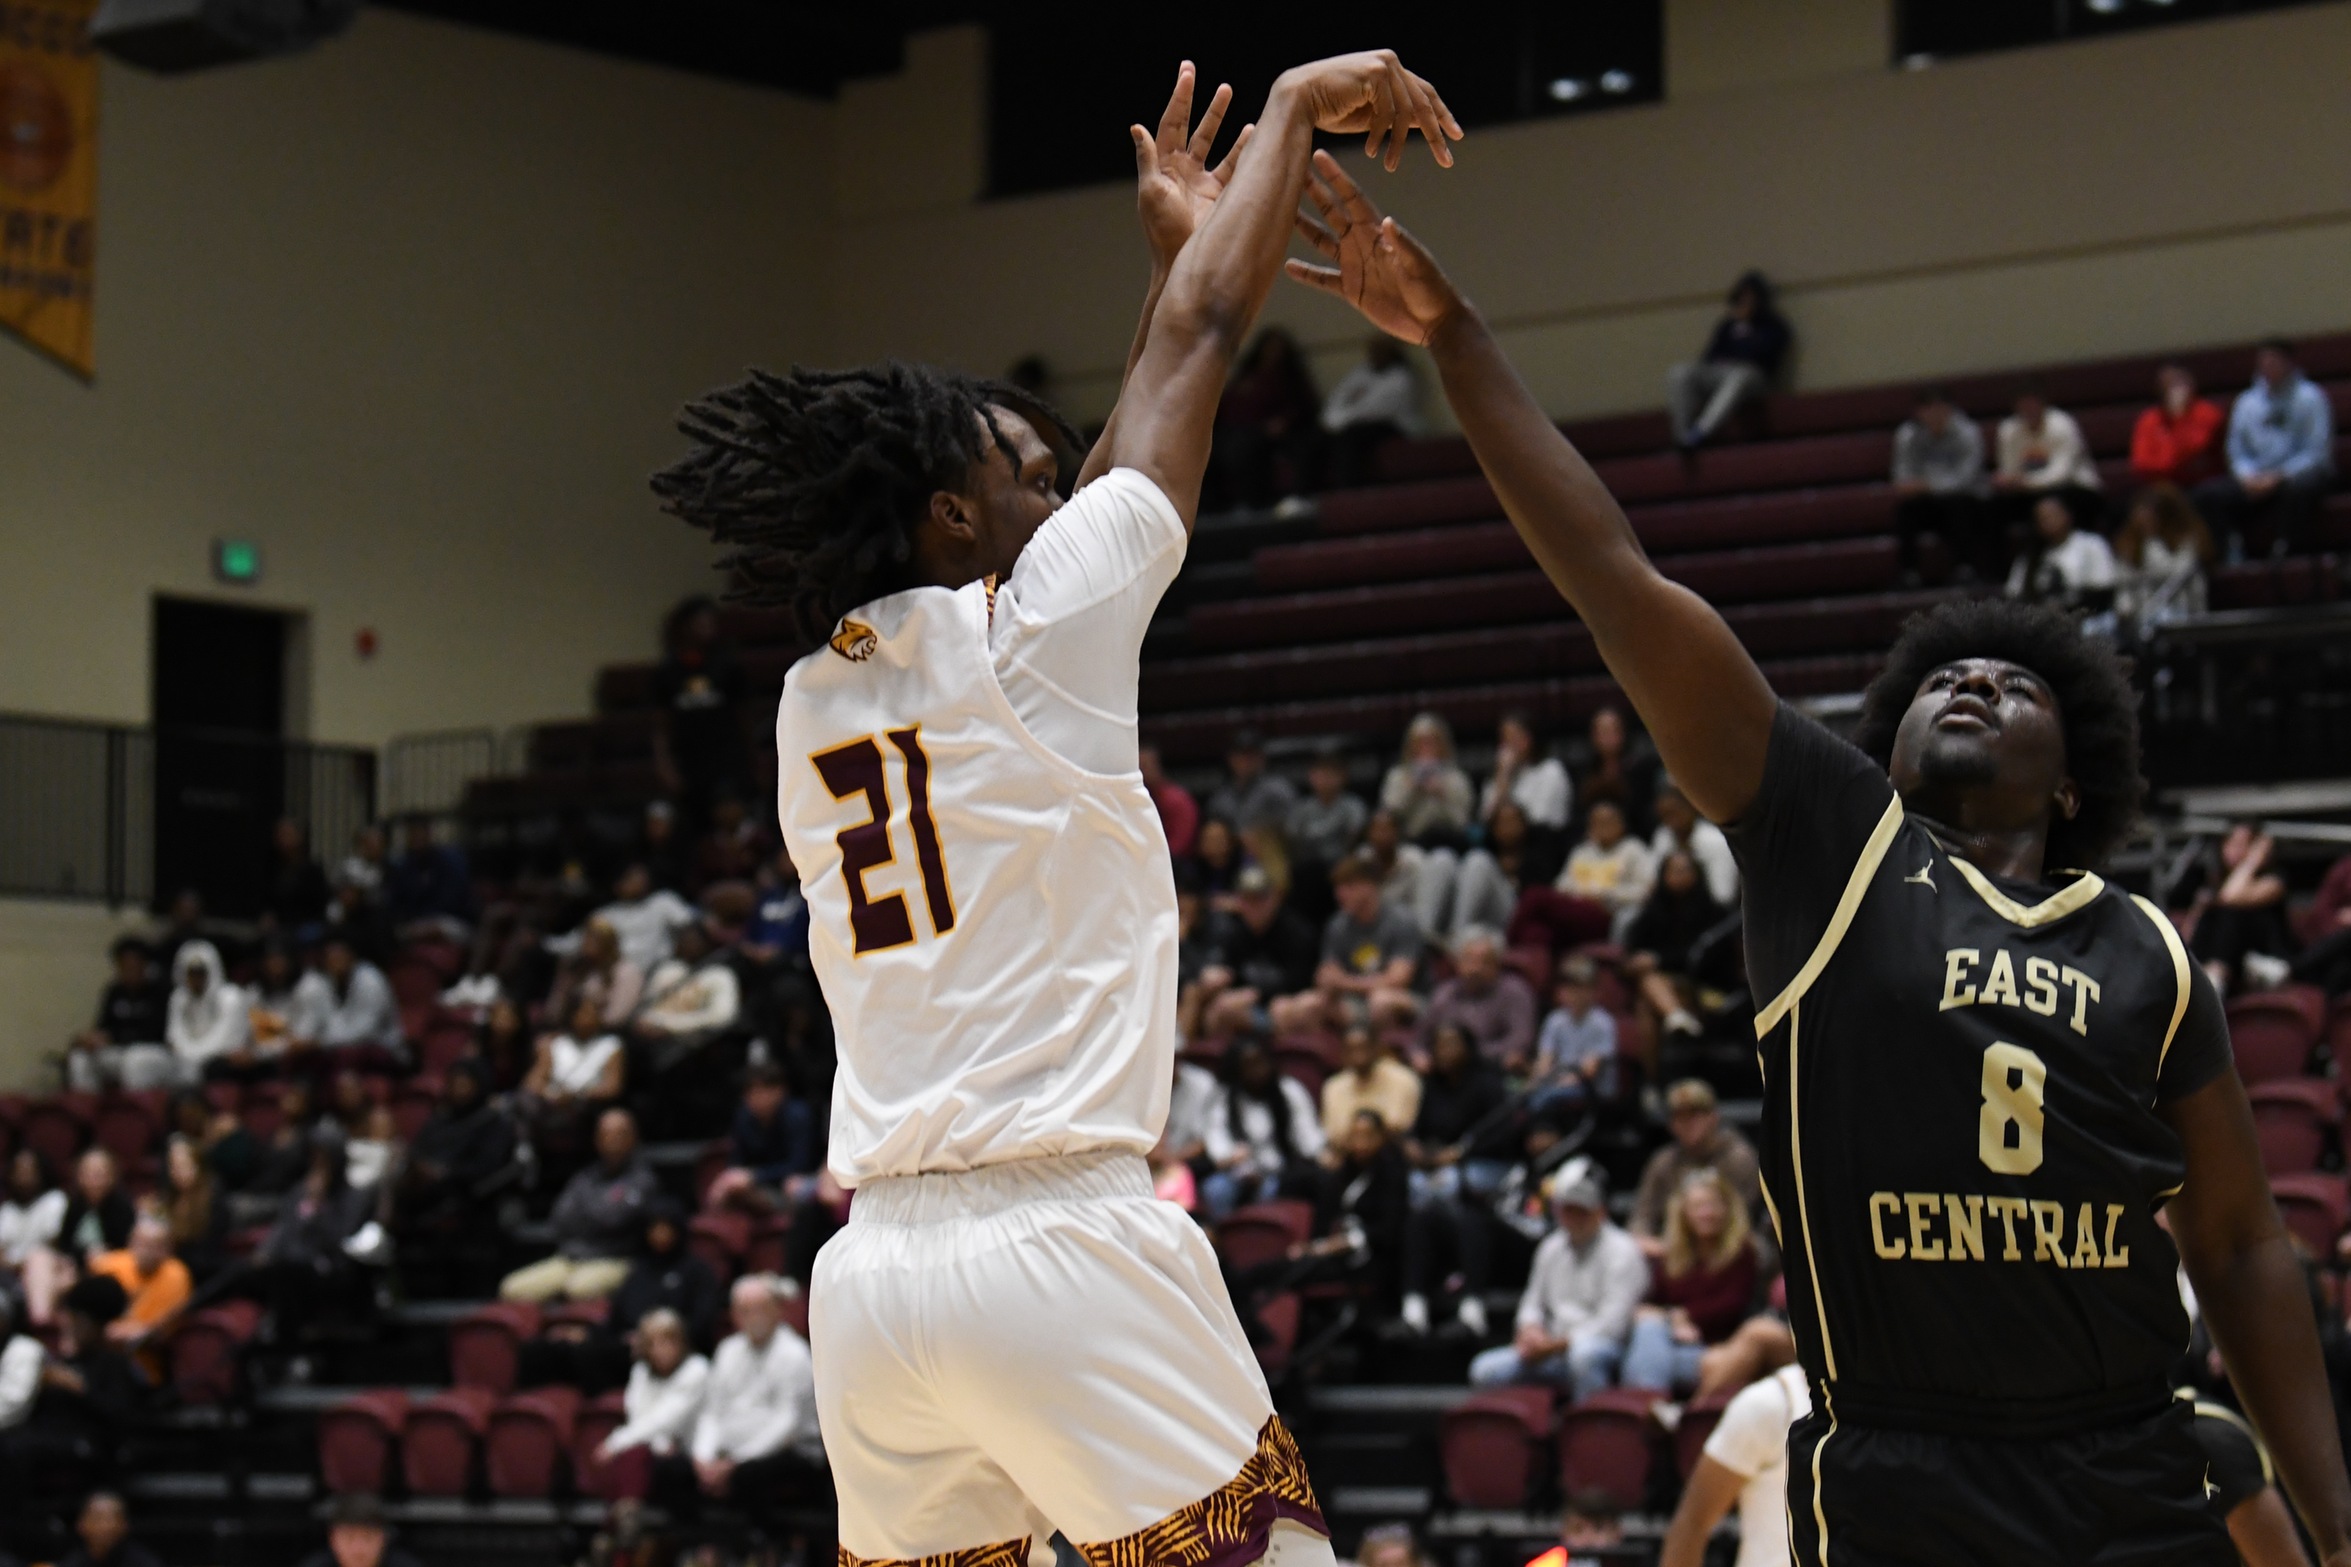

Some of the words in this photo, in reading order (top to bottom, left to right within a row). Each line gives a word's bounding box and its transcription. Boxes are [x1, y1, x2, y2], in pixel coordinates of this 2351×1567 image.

[807, 721, 957, 960] 21
[1939, 948, 2100, 1037] EAST
[1979, 1040, 2047, 1176] 8
[1869, 1191, 2129, 1268] CENTRAL
